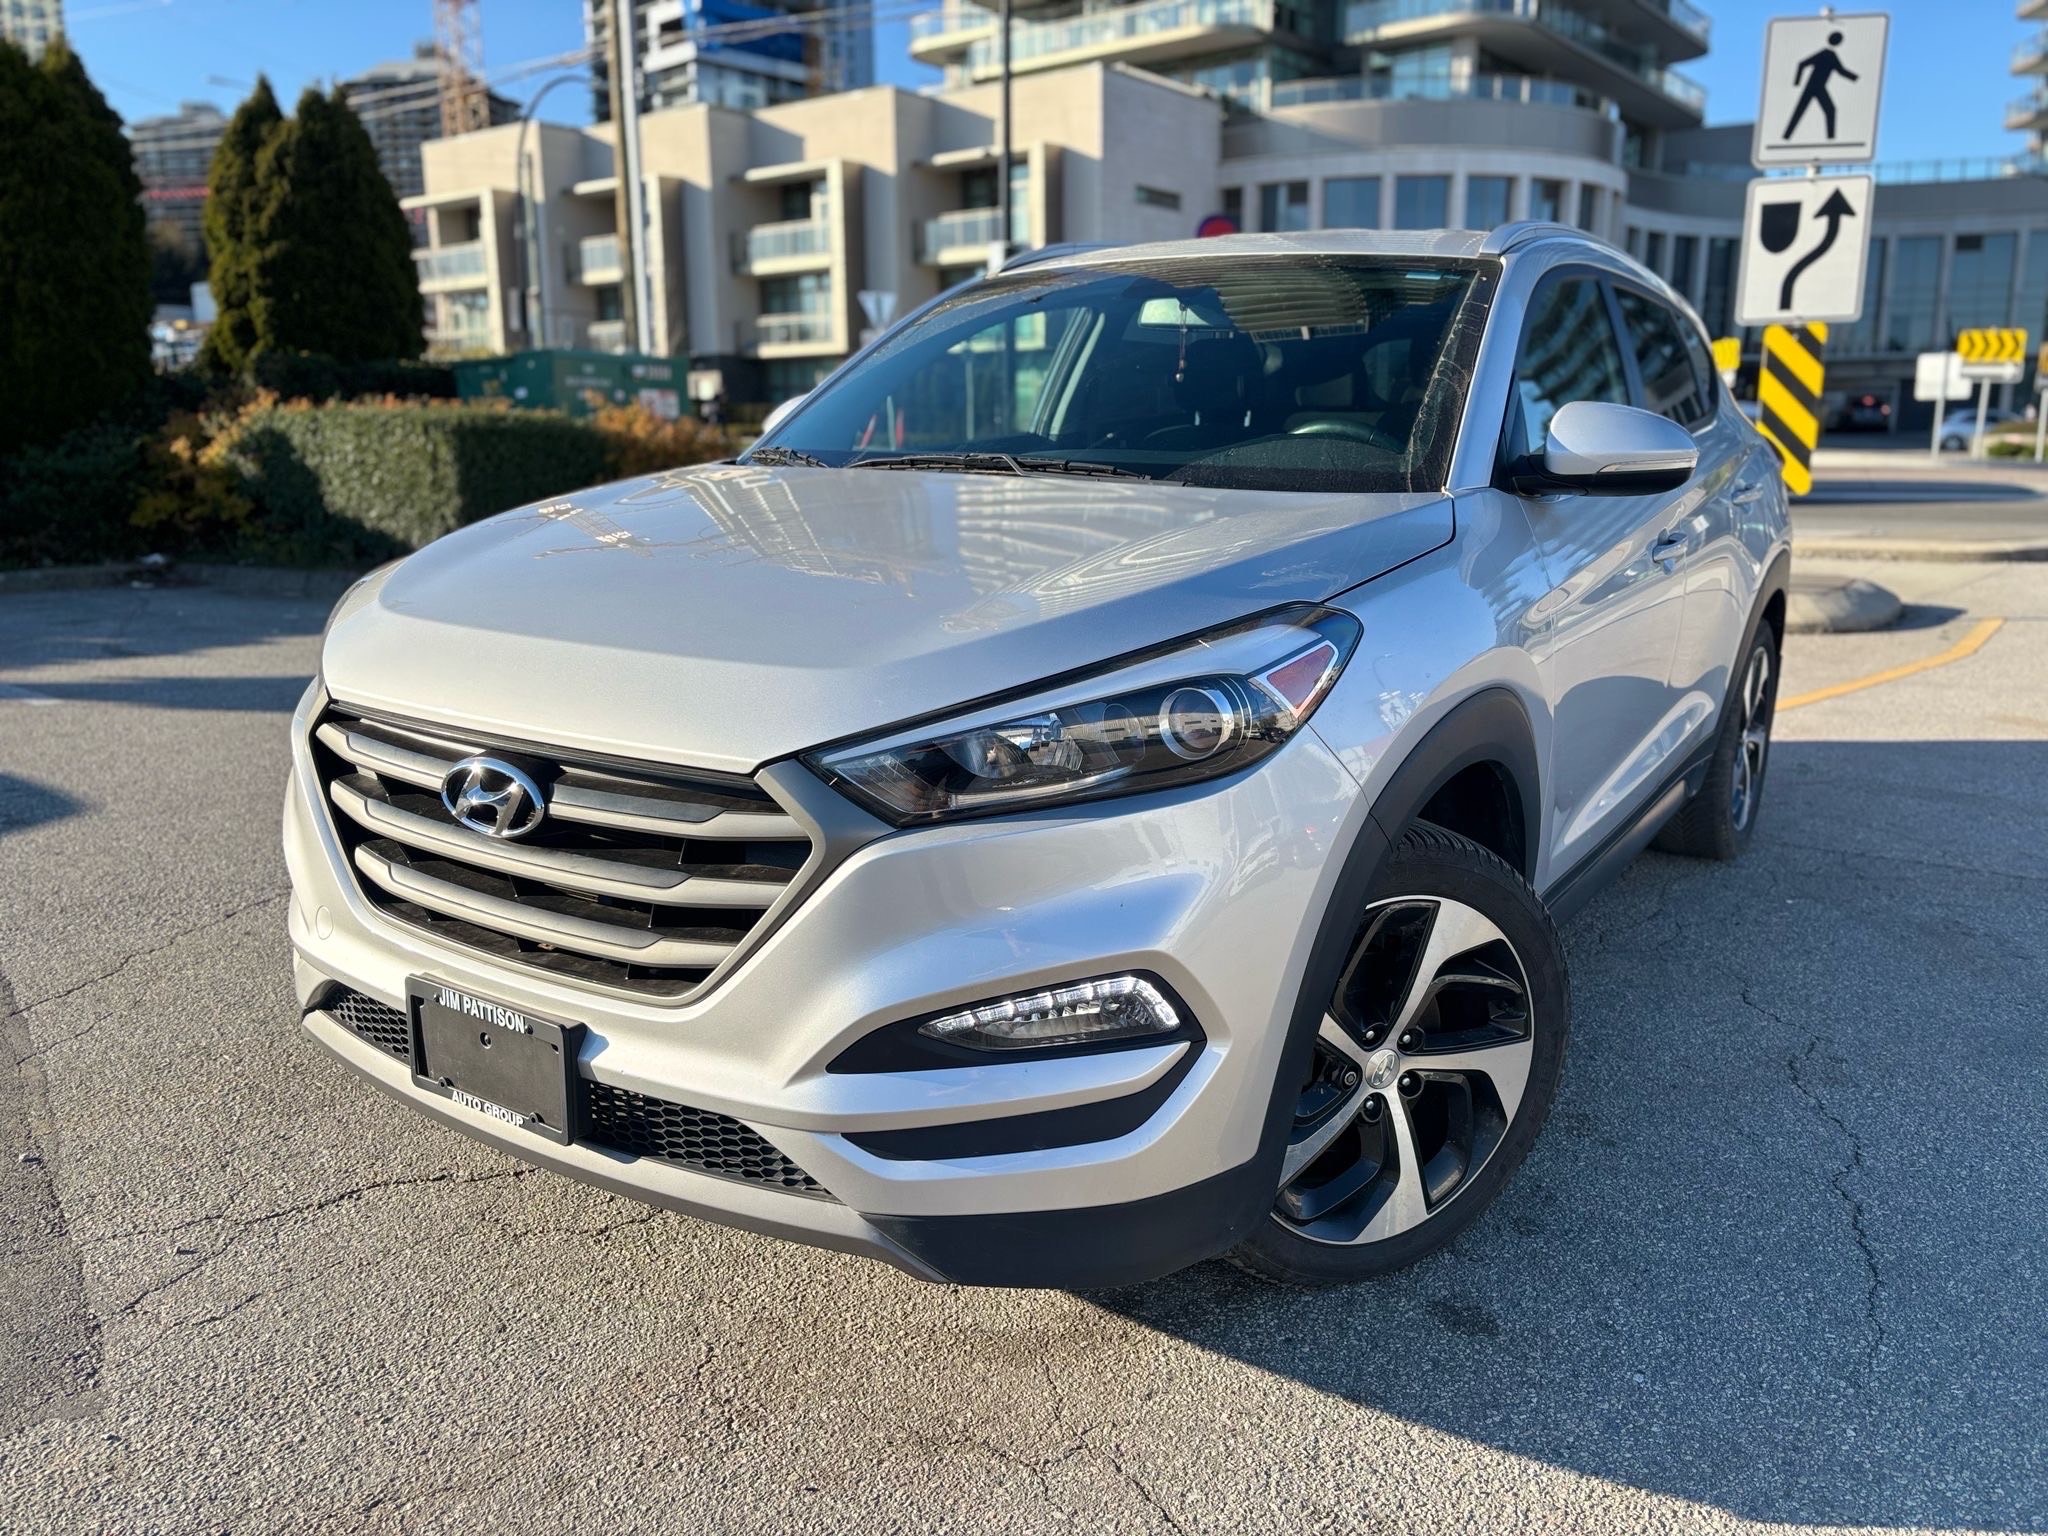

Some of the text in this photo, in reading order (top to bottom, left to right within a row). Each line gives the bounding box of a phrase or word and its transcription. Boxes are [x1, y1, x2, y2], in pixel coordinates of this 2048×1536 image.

[439, 988, 525, 1034] JIM PATTISON
[452, 1090, 524, 1127] AUTO GROUP
